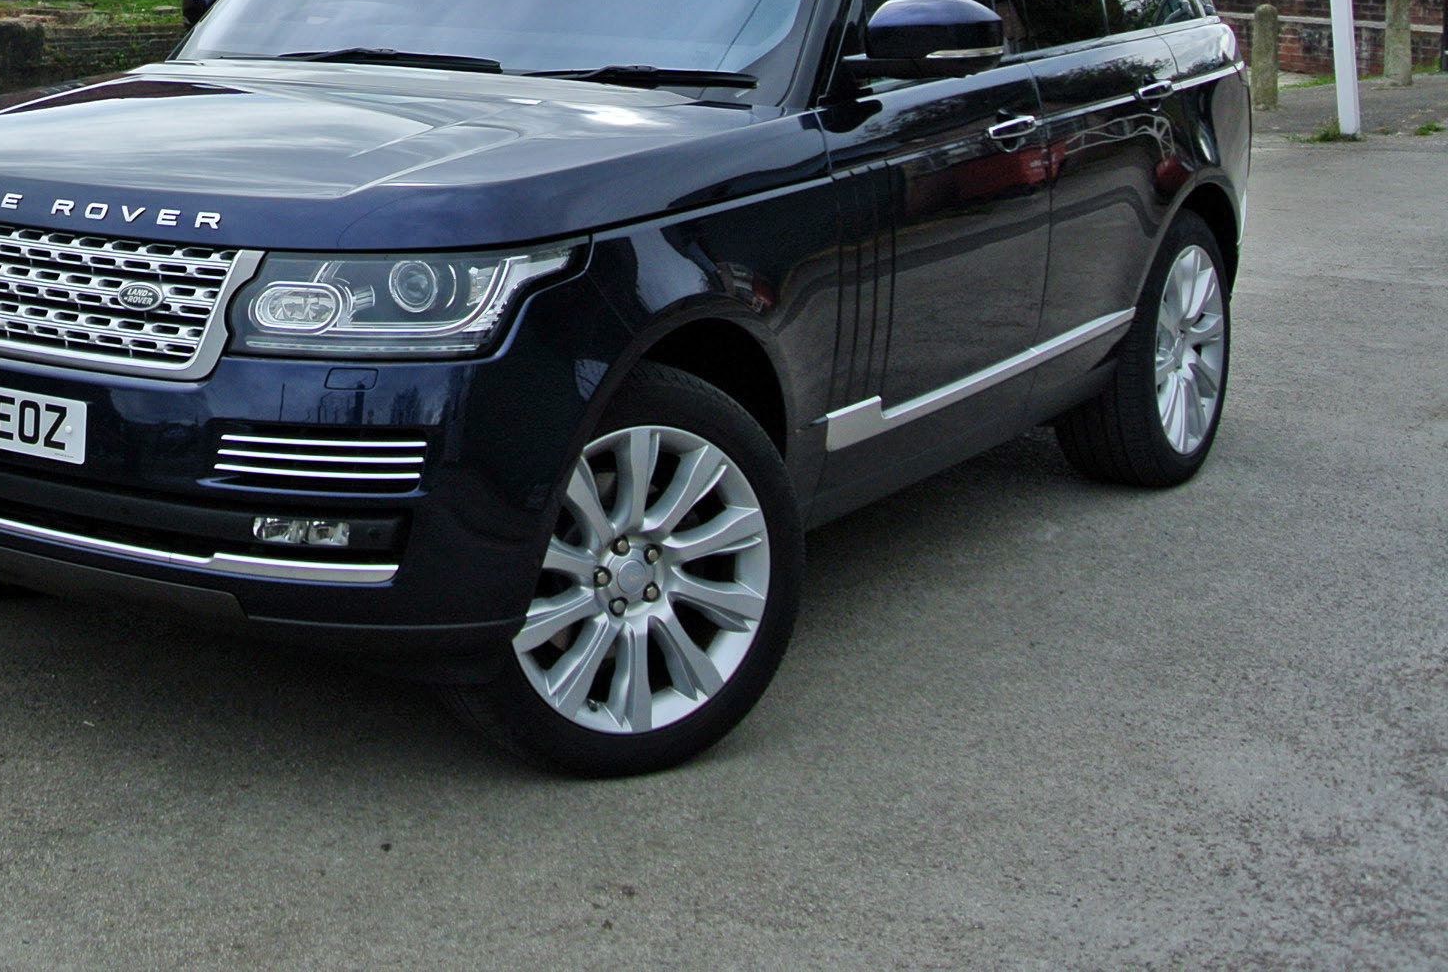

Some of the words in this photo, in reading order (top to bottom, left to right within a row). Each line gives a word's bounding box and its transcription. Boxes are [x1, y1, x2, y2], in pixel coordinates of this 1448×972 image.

[51, 199, 222, 230] ROVER
[127, 288, 149, 296] LAND
[127, 296, 154, 305] ROVER
